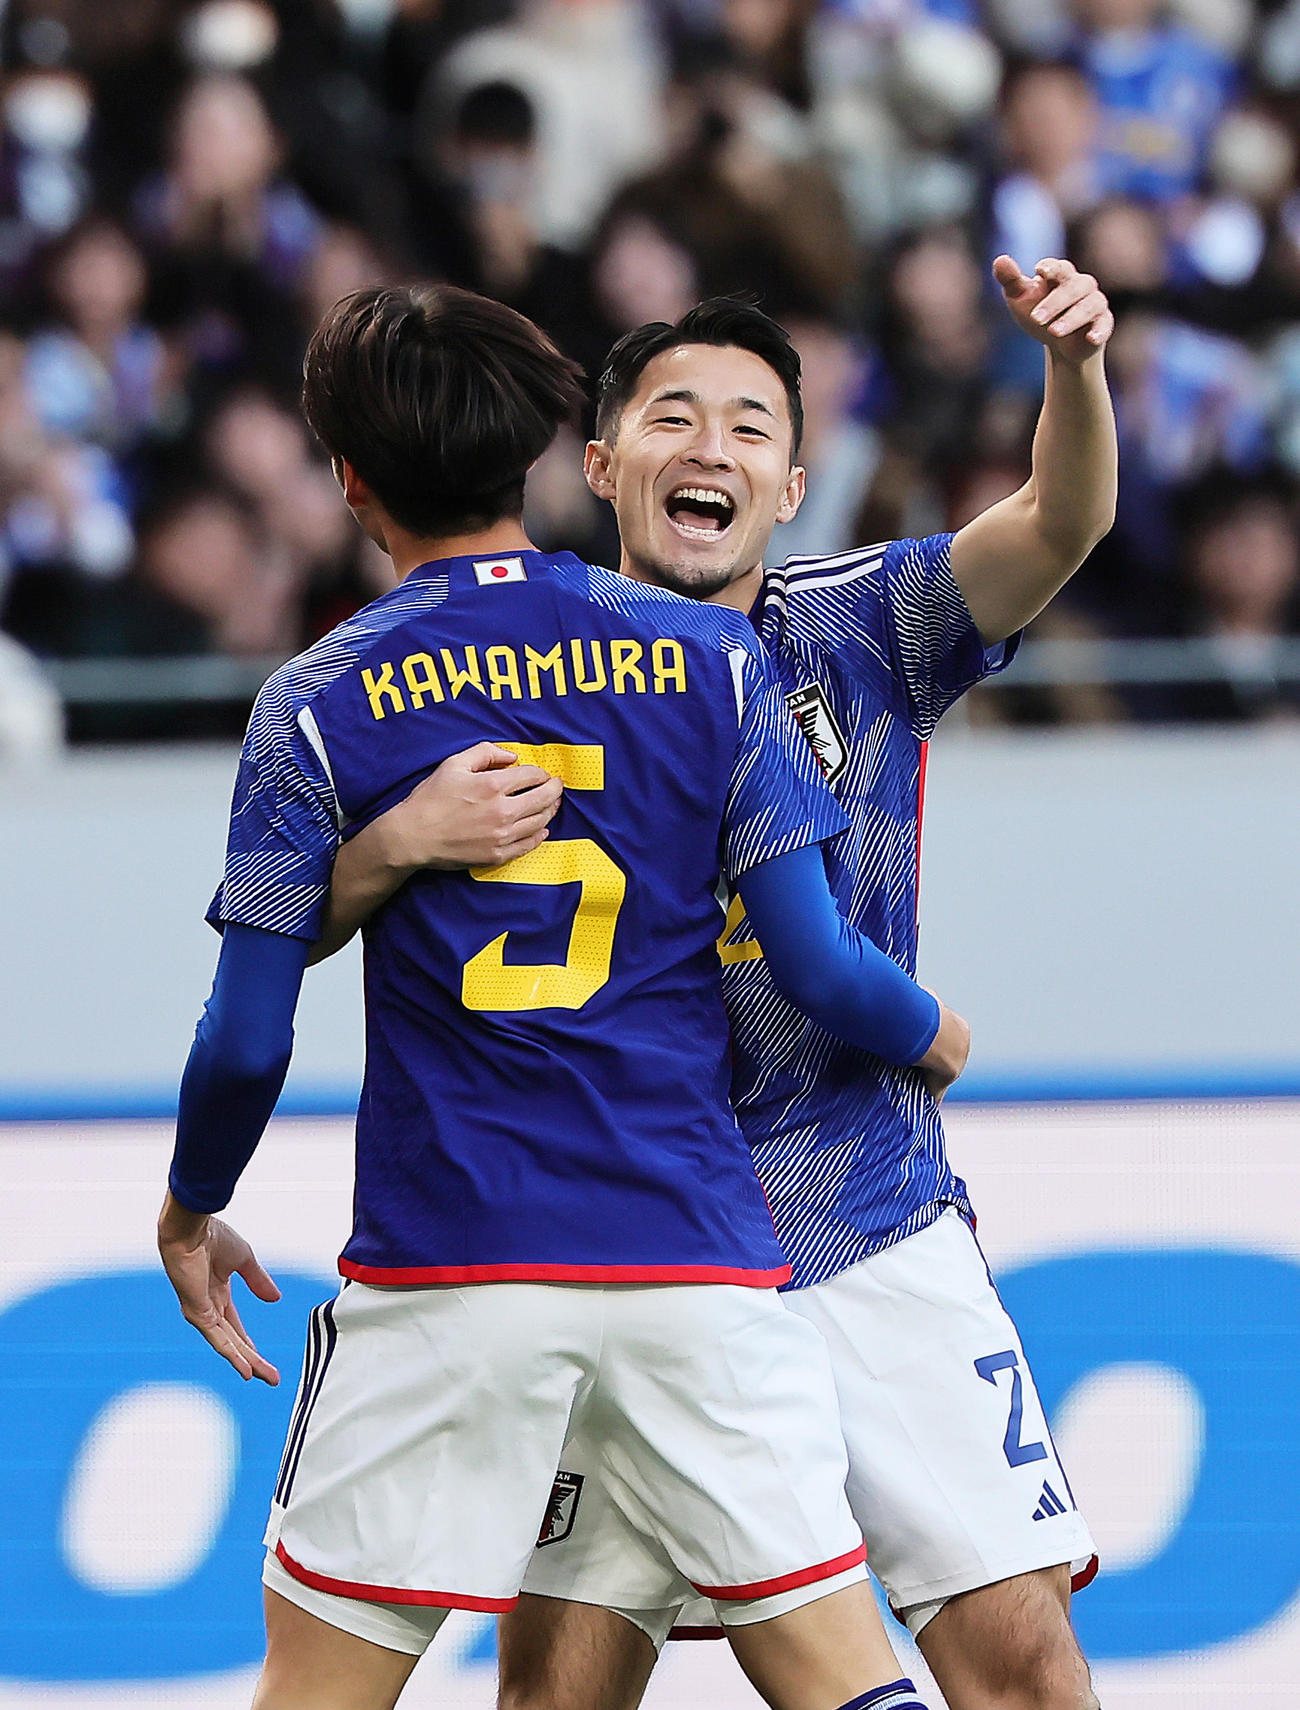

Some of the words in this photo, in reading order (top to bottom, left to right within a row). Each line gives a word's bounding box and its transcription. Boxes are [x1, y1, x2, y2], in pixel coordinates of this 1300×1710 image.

[361, 638, 687, 720] KAWAMURA
[462, 742, 626, 1011] 5
[974, 1350, 1049, 1468] 2
